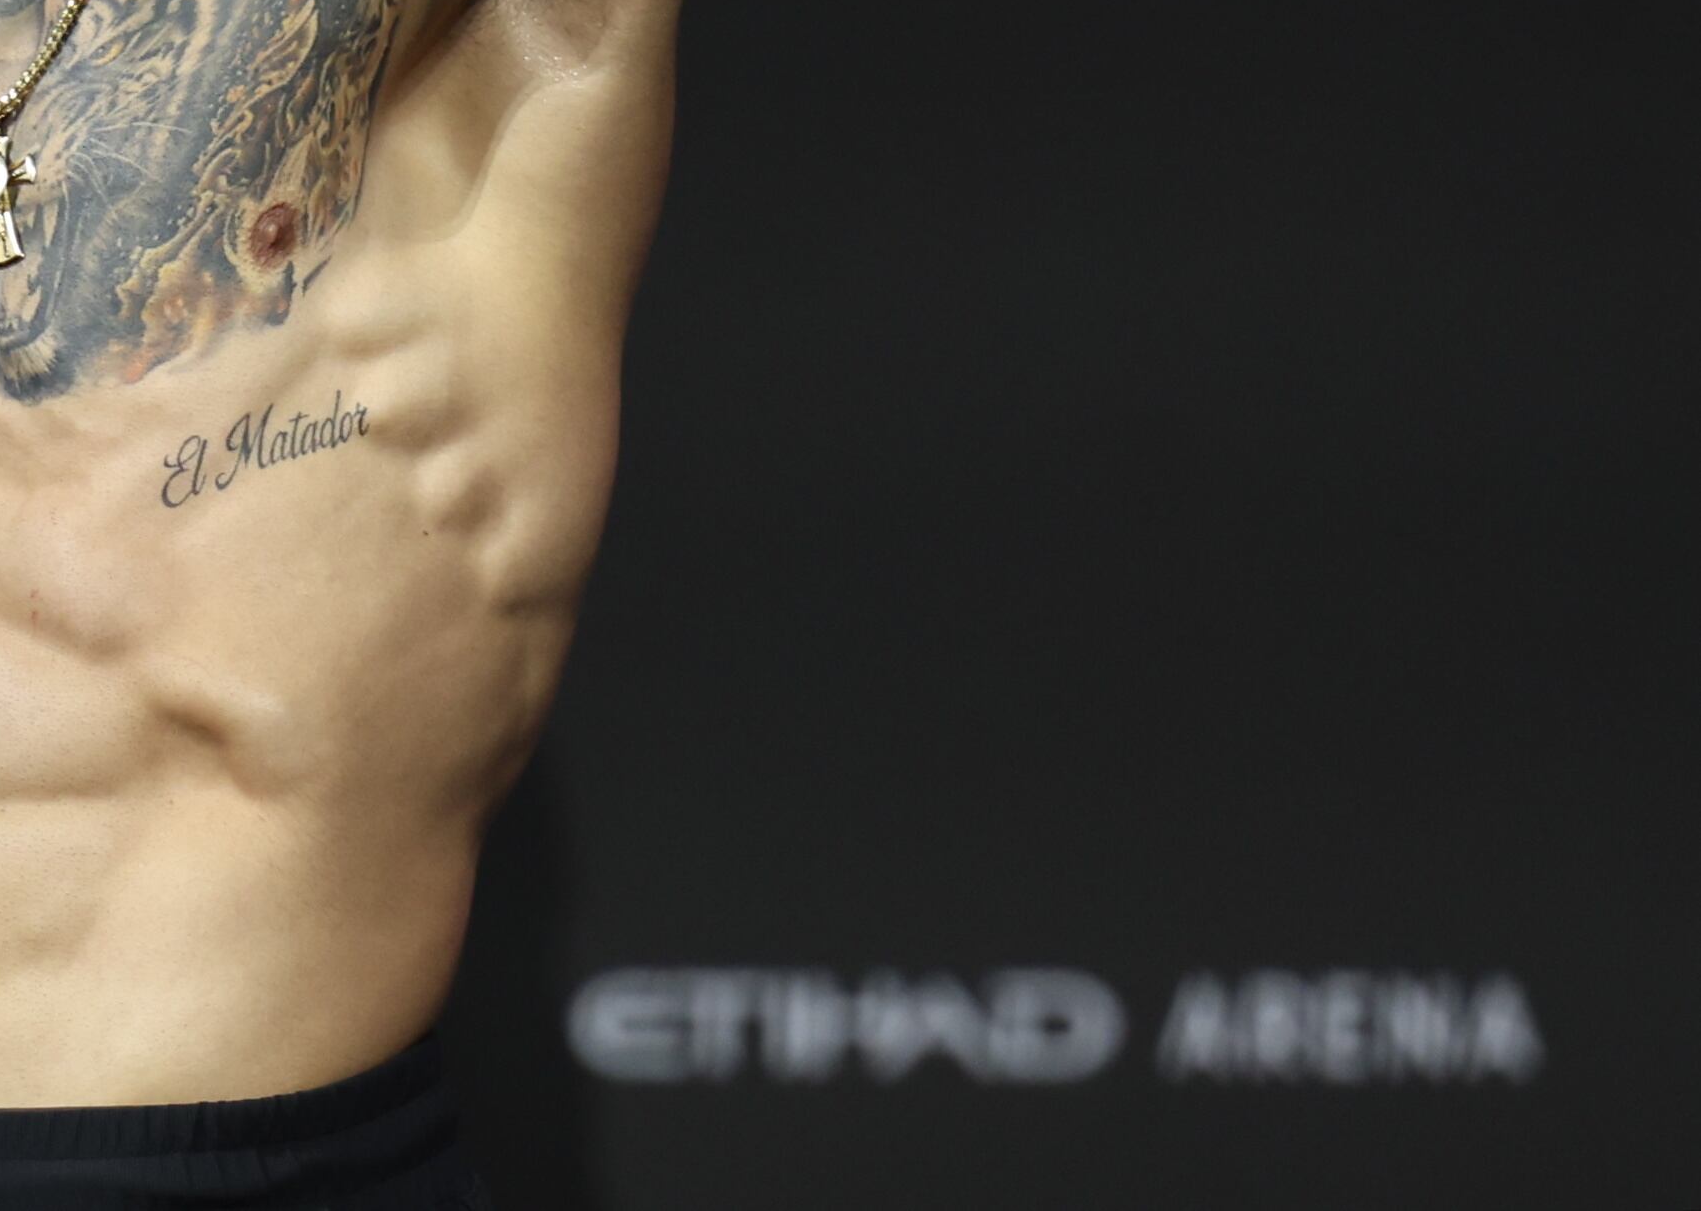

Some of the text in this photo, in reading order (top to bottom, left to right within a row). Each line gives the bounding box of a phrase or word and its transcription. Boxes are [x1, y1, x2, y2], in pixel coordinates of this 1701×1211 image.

[161, 389, 371, 509] El Matador
[569, 968, 1539, 1081] ETIHAD ARENA
